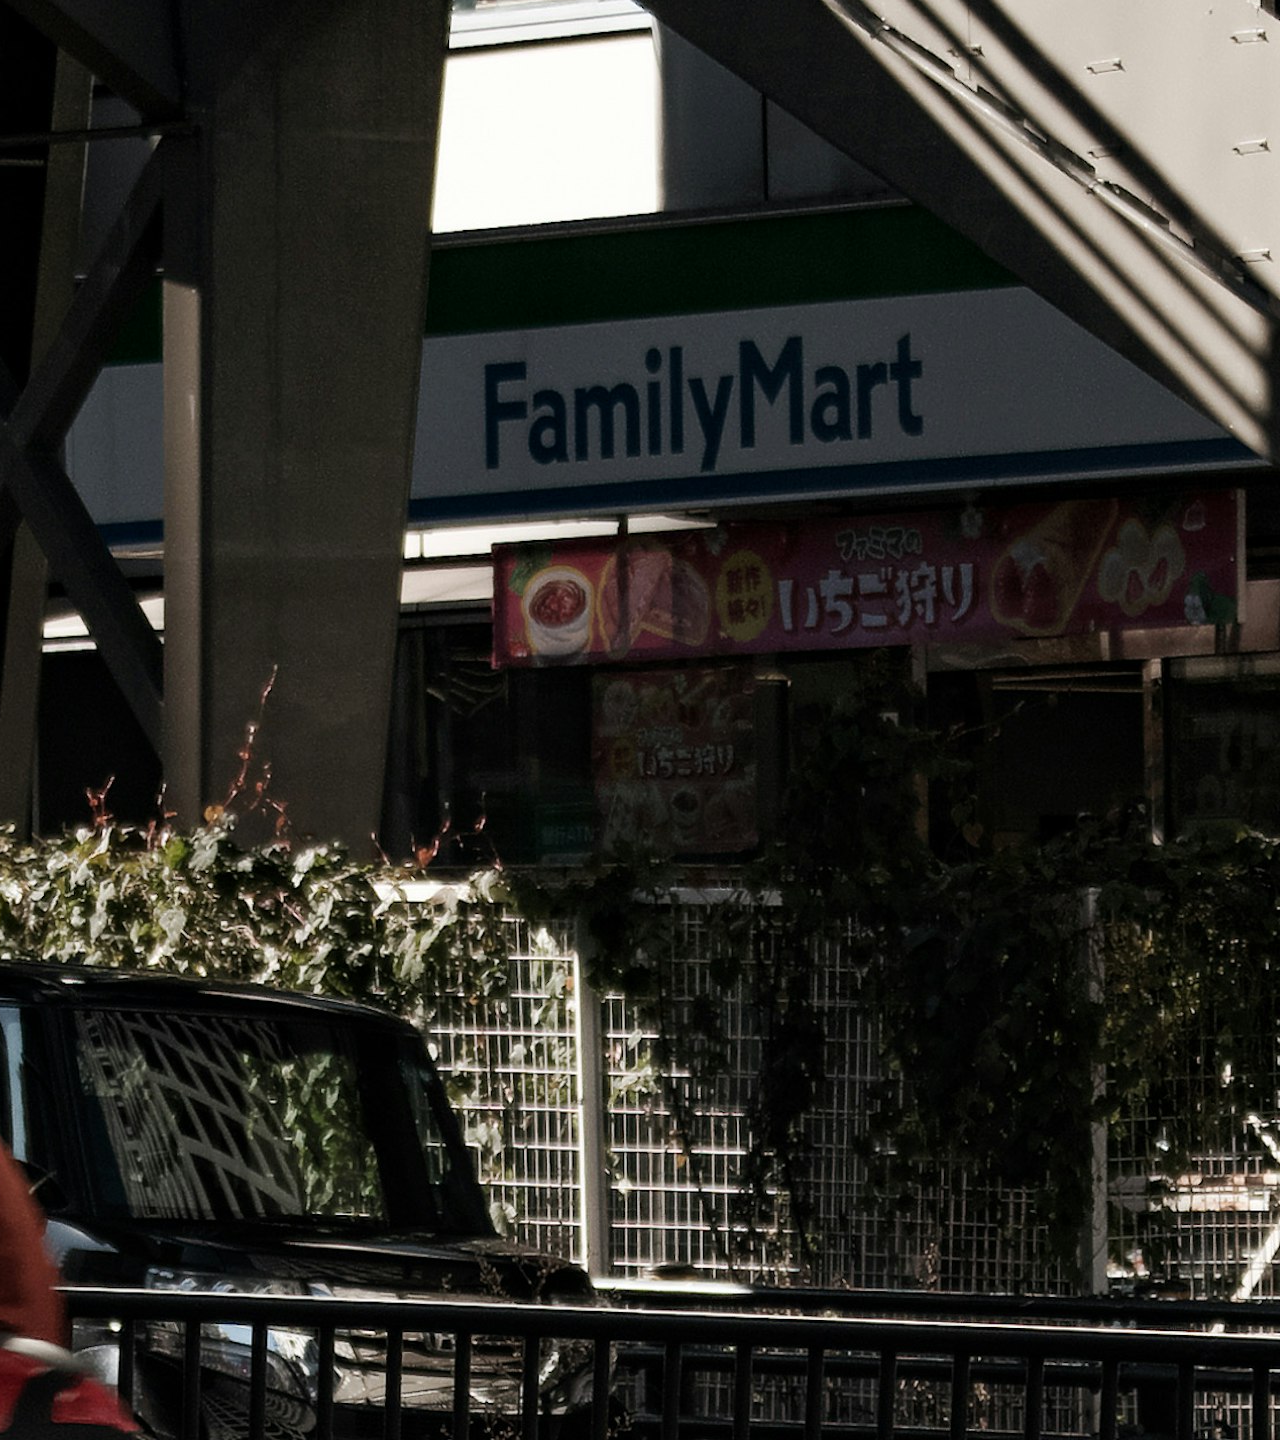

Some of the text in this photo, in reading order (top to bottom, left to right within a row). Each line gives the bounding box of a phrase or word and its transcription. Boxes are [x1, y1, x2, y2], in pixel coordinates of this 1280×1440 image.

[484, 333, 924, 472] FamilyMart
[778, 561, 974, 633] いちご狩り
